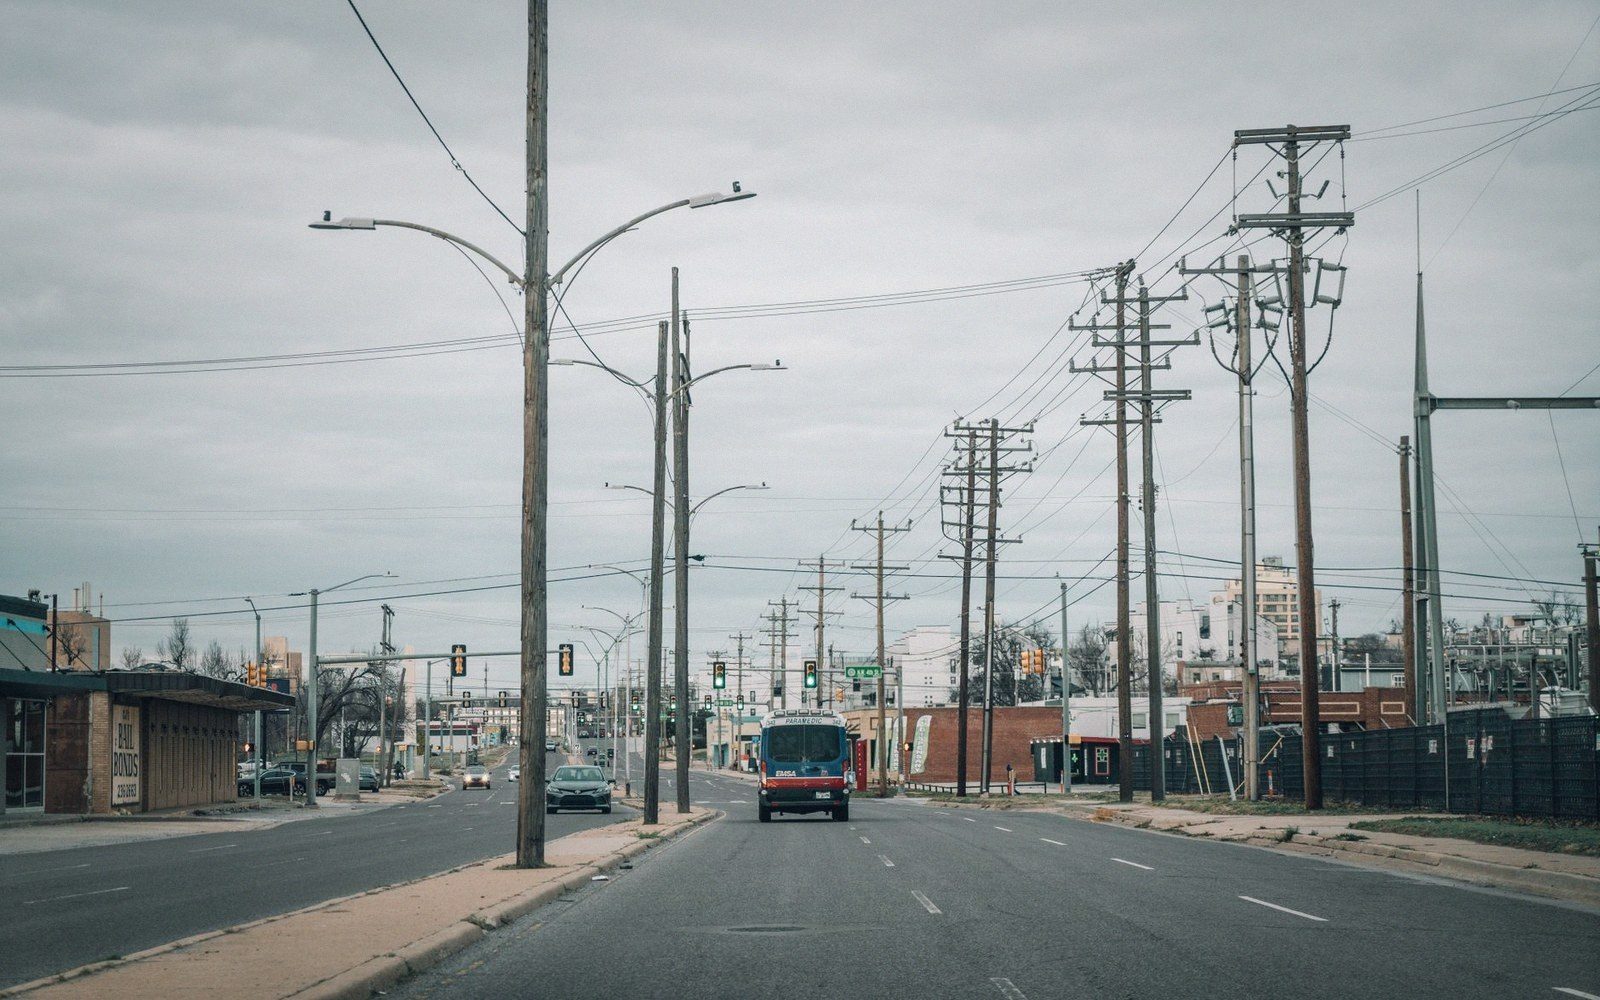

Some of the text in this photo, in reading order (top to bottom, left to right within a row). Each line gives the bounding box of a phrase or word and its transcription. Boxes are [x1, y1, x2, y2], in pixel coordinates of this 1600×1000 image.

[785, 717, 823, 725] PARAMEDIC
[118, 723, 134, 750] BAIL
[113, 752, 138, 777] BONDS
